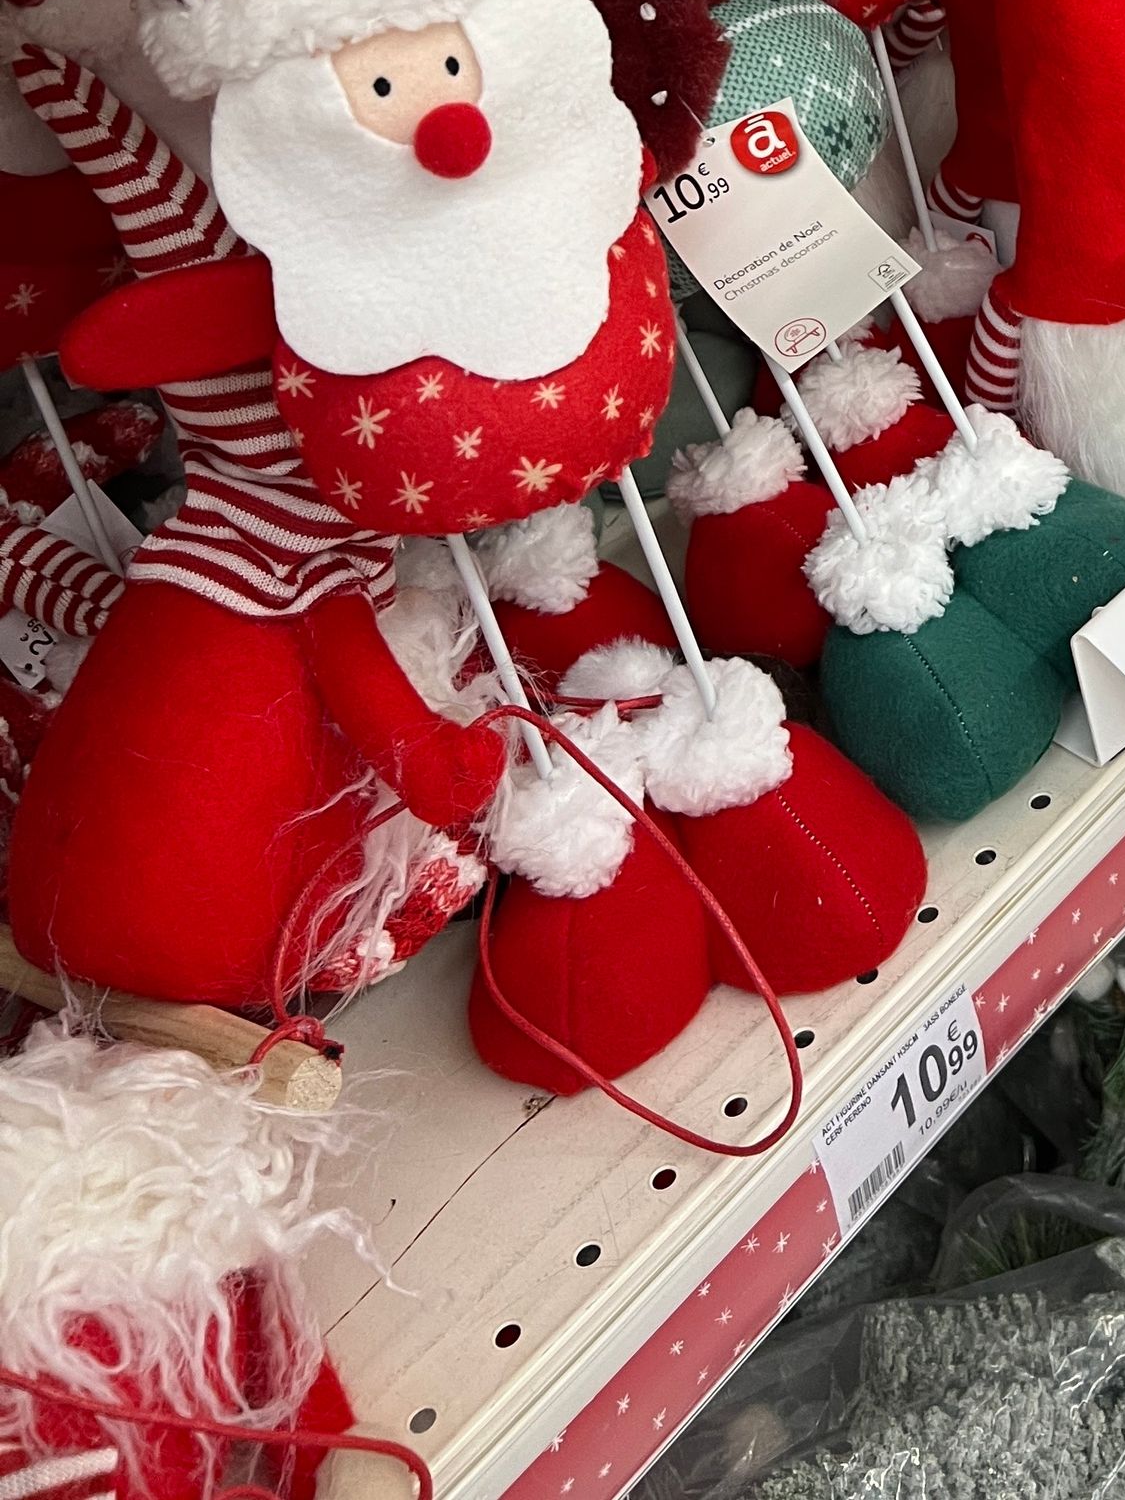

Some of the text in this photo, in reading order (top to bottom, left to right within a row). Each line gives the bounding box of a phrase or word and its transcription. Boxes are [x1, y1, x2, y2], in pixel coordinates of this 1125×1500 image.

[713, 220, 823, 291] Décoration de Noël
[724, 228, 839, 302] Christmas decoration
[821, 1117, 836, 1137] ACT
[836, 1085, 868, 1123] FIGURINE
[866, 1057, 898, 1090] DANSANT
[898, 1032, 919, 1059] H35CM
[918, 1079, 969, 1136] 10,99€/u
[825, 1096, 872, 1146] CERF PERENO
